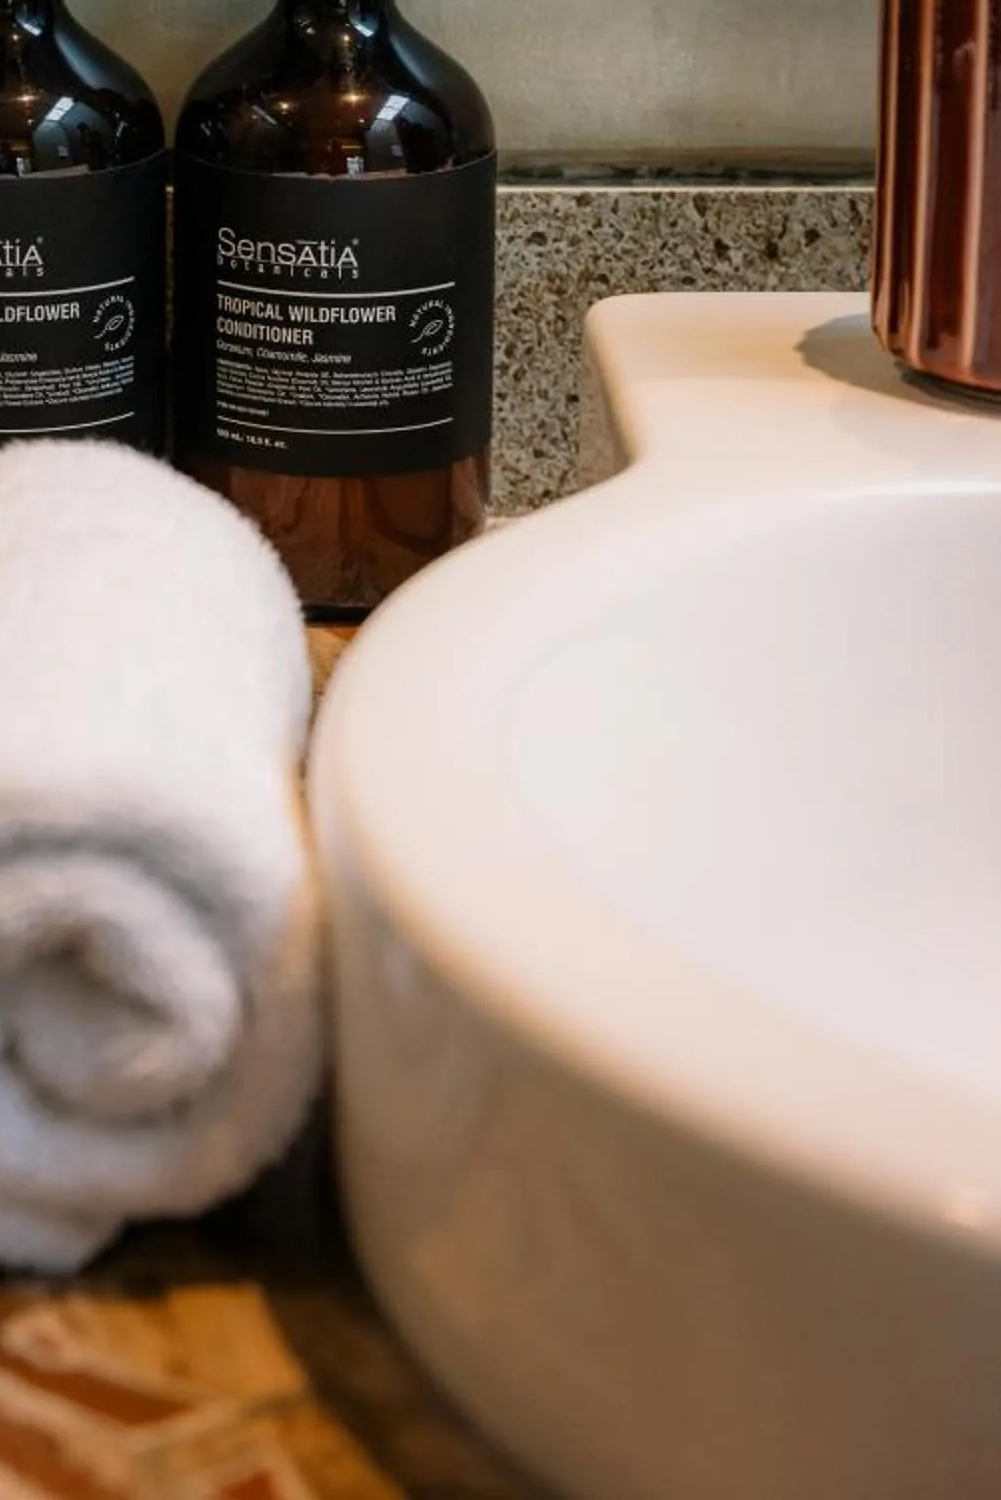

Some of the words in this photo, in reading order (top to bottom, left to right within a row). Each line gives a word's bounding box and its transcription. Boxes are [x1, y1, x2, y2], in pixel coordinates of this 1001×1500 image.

[217, 294, 283, 322] TROPICAL
[289, 305, 396, 324] WILDFLOWER
[217, 317, 314, 346] CONDITIONER
